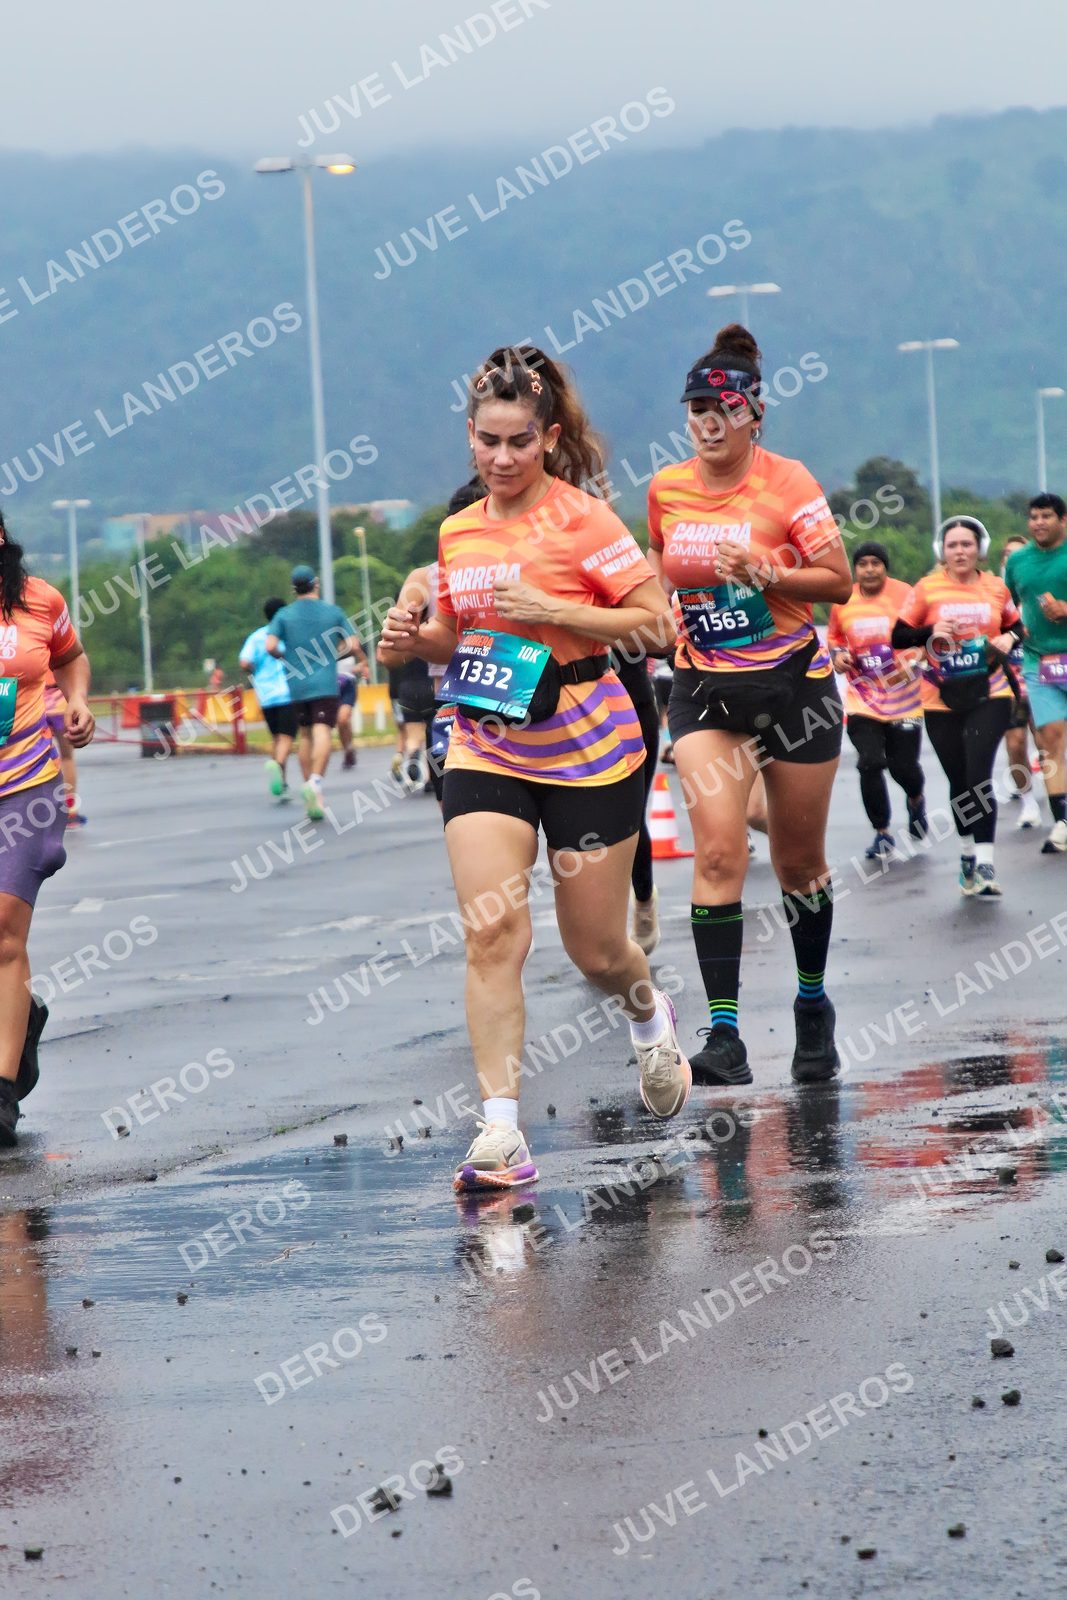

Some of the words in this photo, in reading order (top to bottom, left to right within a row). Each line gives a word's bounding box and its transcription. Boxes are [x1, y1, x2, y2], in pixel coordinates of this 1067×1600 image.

[672, 521, 751, 545] CARRERA
[668, 543, 719, 557] OMNILI
[698, 610, 750, 632] 1563
[517, 645, 542, 664] 10K
[947, 652, 980, 667] 1407
[459, 659, 513, 690] 1332
